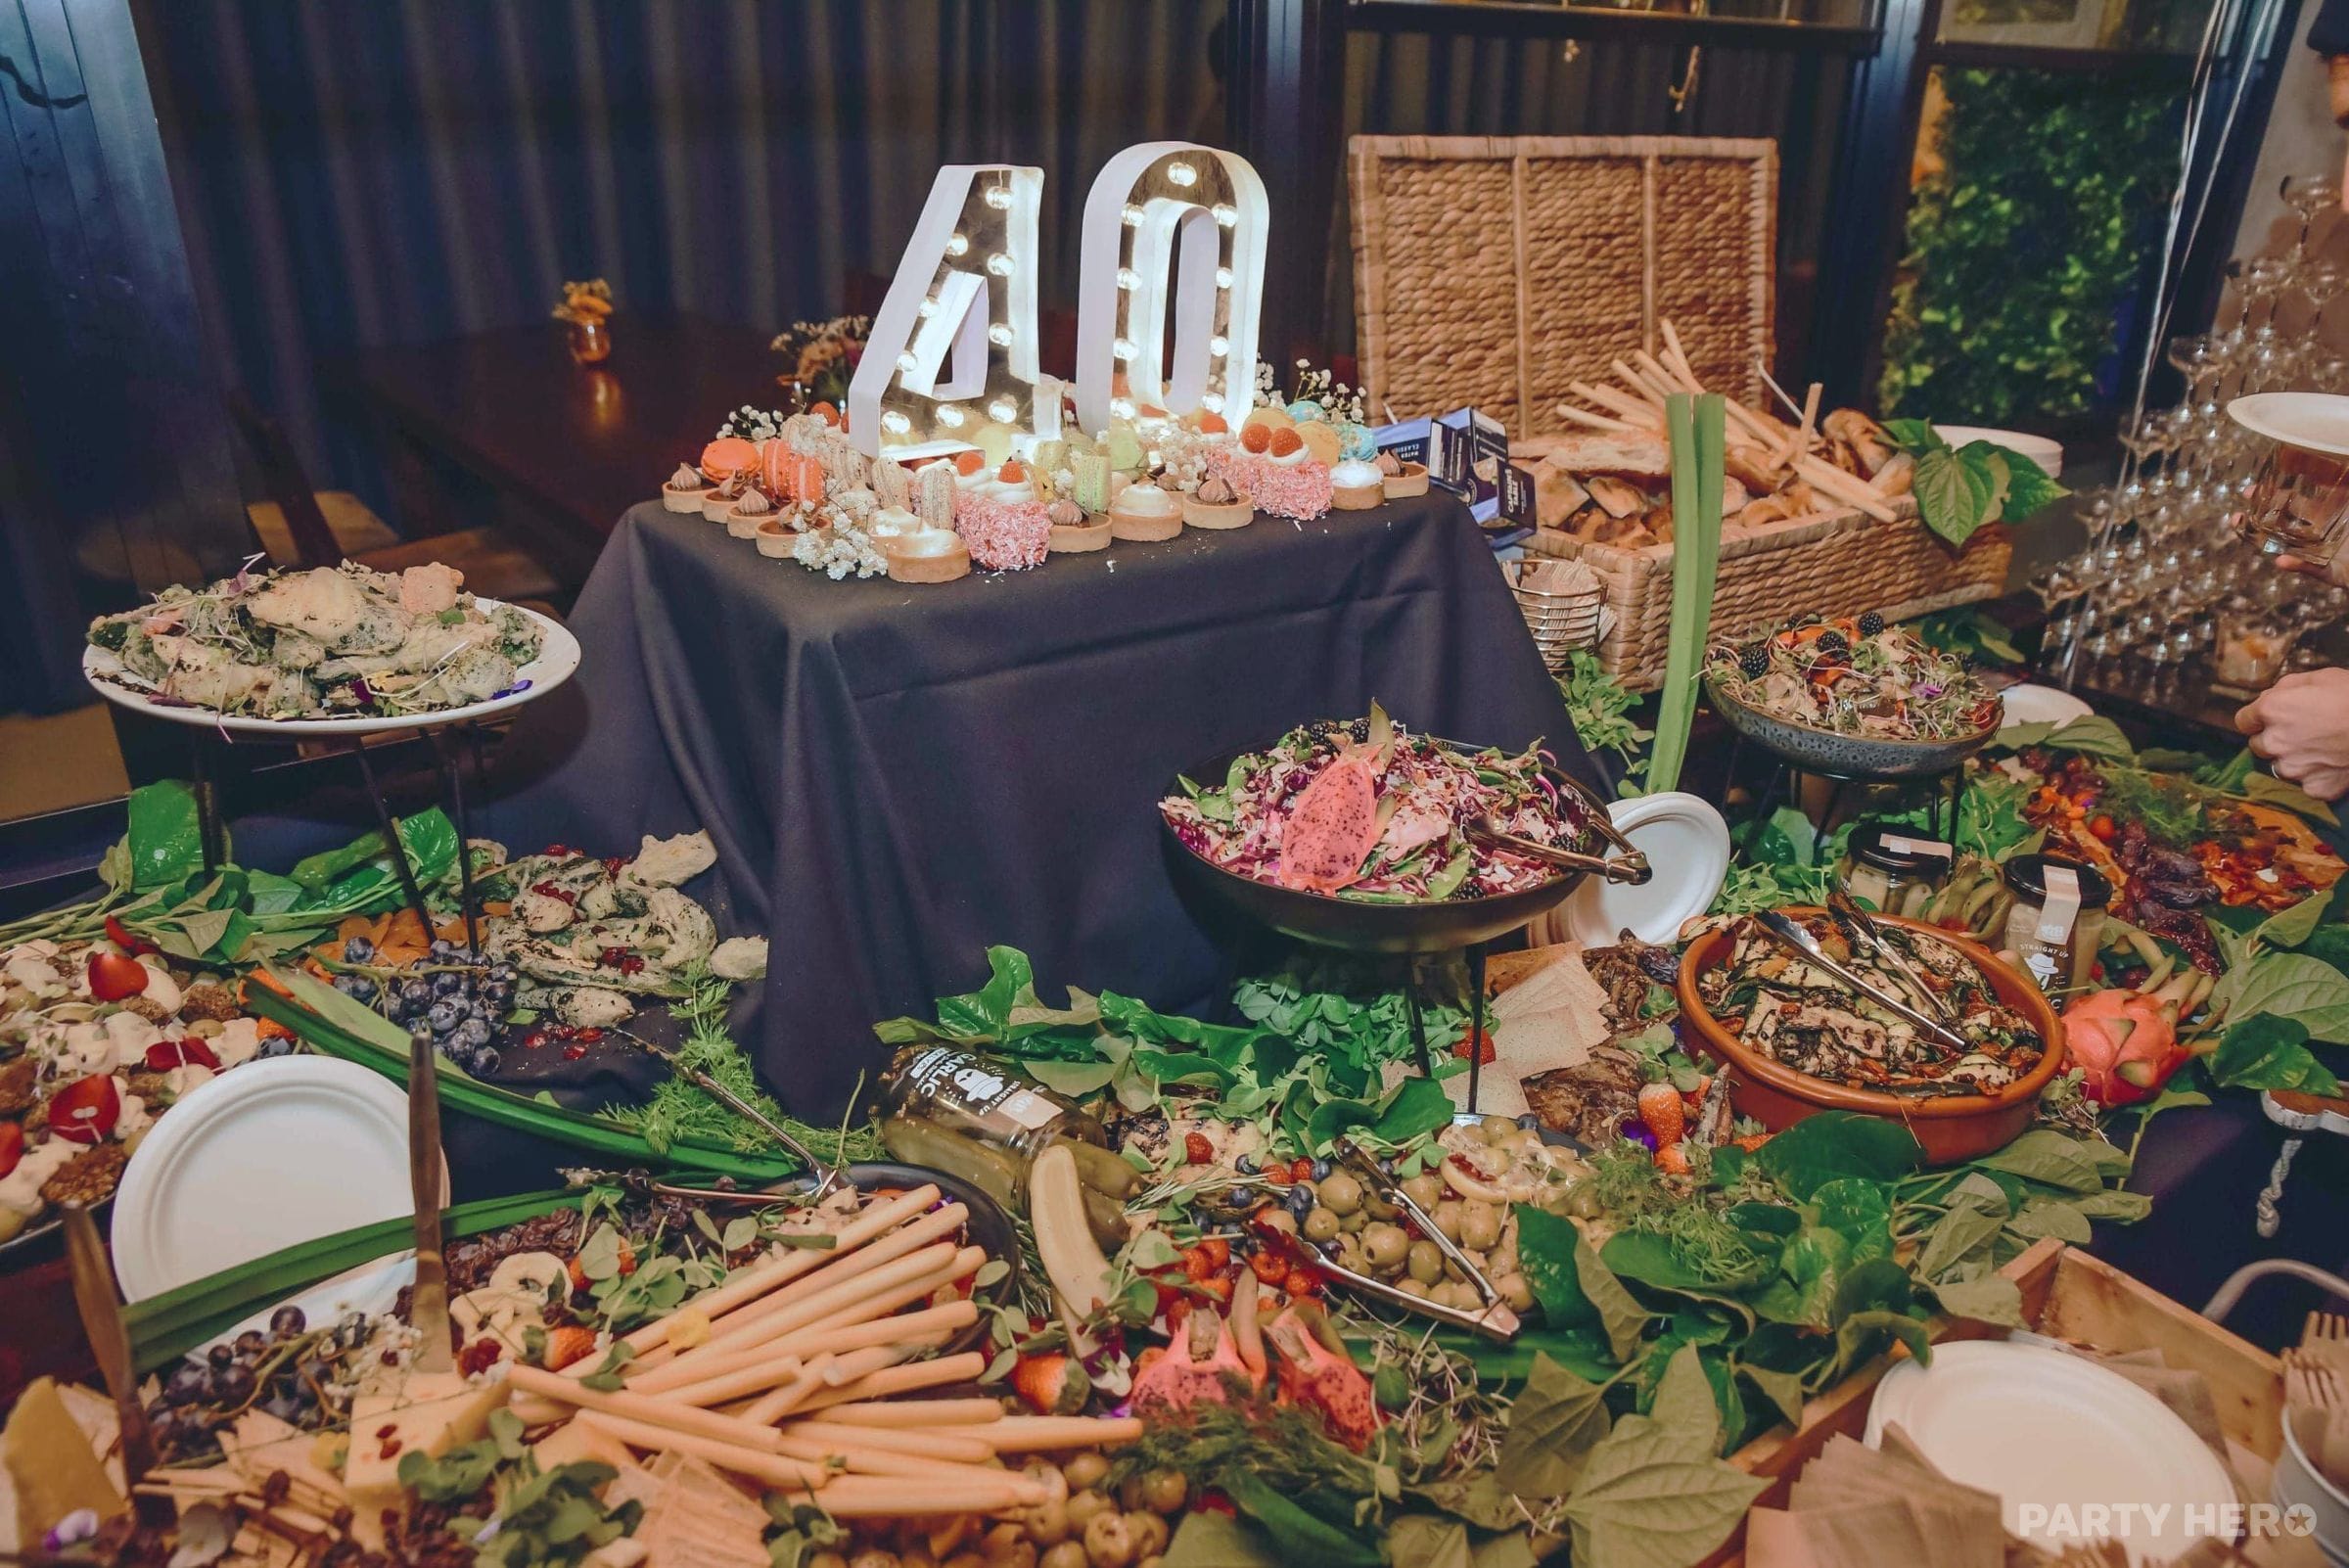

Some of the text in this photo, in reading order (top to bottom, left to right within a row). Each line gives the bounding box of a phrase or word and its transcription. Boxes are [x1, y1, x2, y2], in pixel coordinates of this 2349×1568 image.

[850, 141, 1270, 460] 40
[2019, 943, 2057, 954] STRAIGHT
[921, 1052, 978, 1098] GARLIC
[990, 1080, 1022, 1107] STRAIGHT
[979, 1105, 990, 1116] UP
